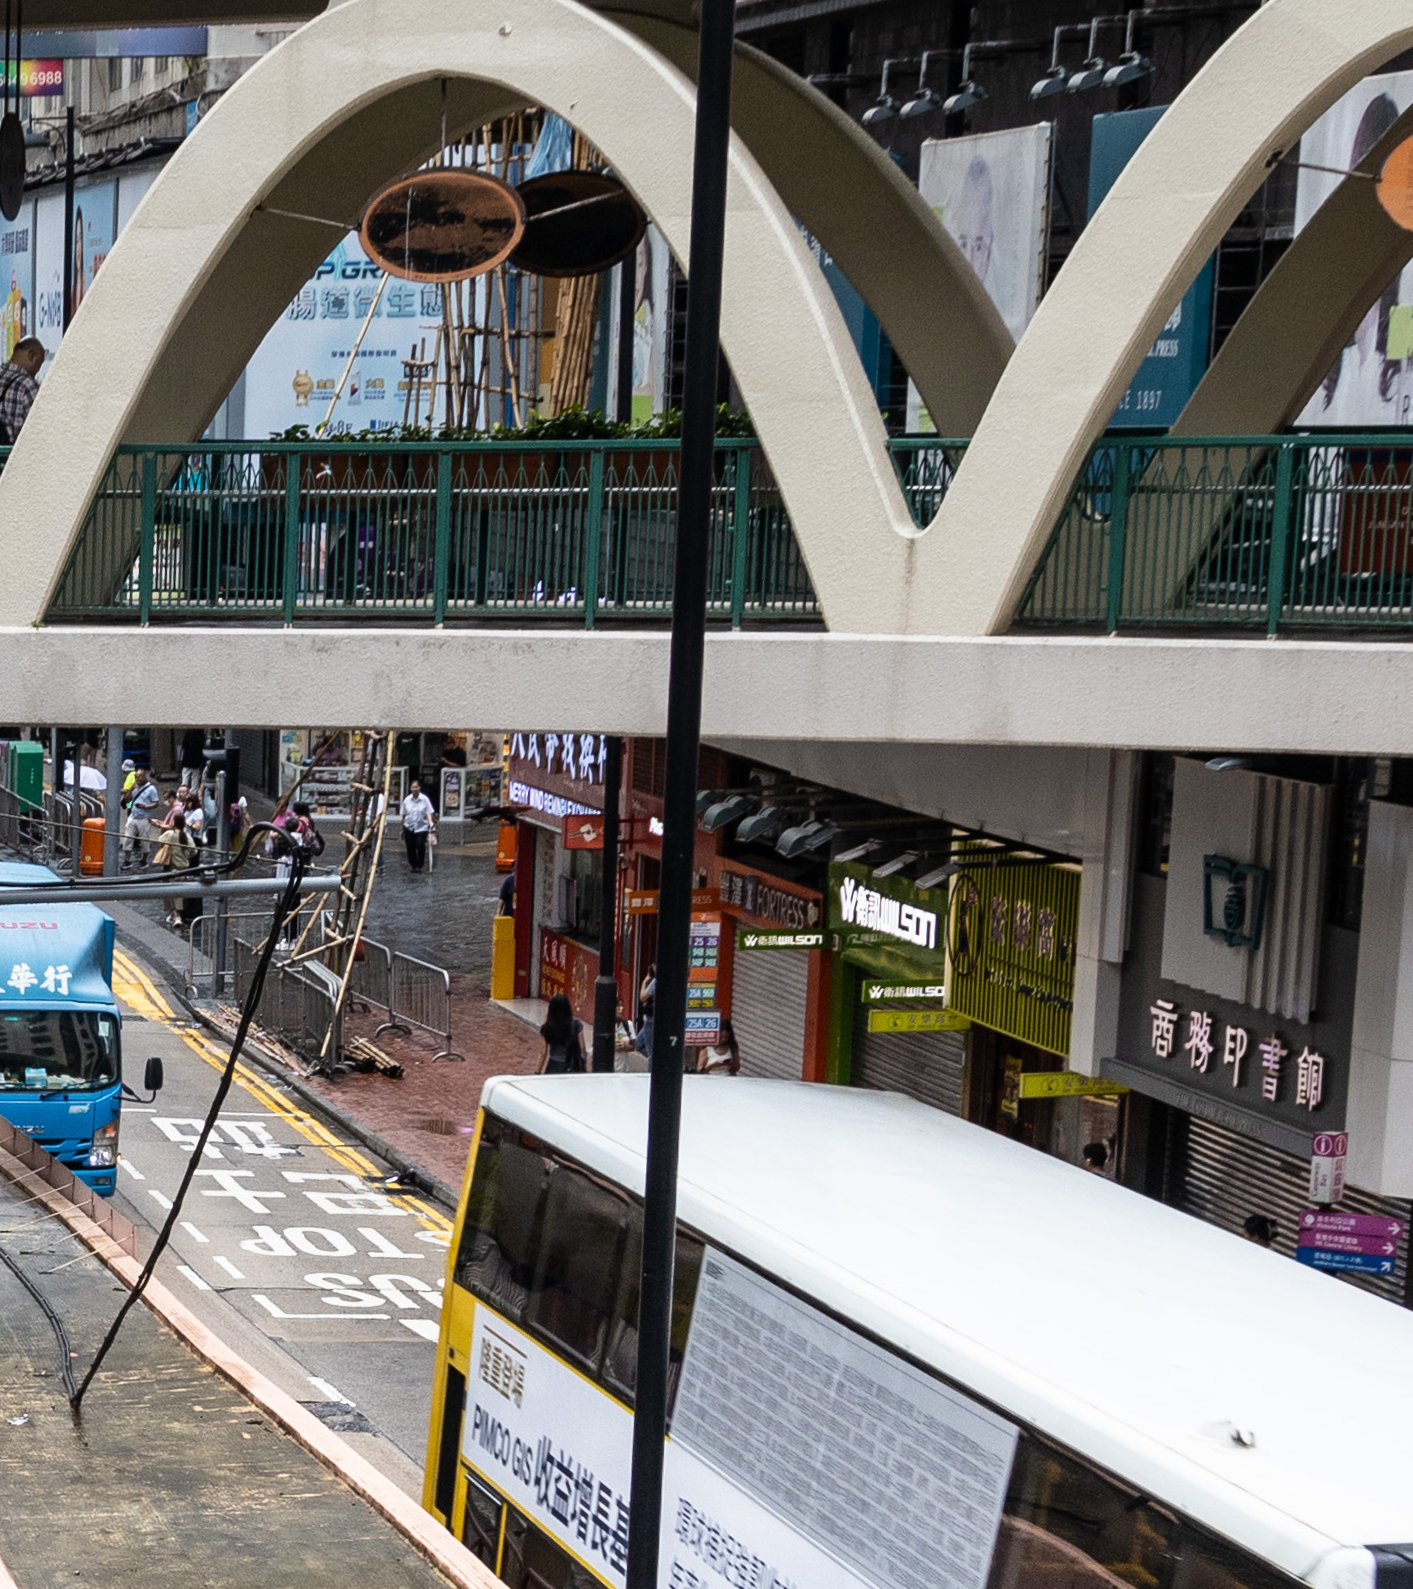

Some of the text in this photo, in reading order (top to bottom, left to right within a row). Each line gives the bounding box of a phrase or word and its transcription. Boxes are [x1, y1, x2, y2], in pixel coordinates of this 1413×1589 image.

[29, 70, 62, 85] 6988
[1137, 391, 1162, 410] 1897
[693, 895, 713, 905] RESS
[757, 884, 805, 930] FORTRESS
[881, 896, 937, 950] WILSON
[778, 934, 823, 946] WILSON
[906, 985, 945, 998] WILSO
[704, 1018, 717, 1028] 26
[1149, 998, 1325, 1112] 商務印書館
[304, 1272, 452, 1310] US
[472, 1403, 511, 1467] PIMCO
[512, 1436, 533, 1487] GIS
